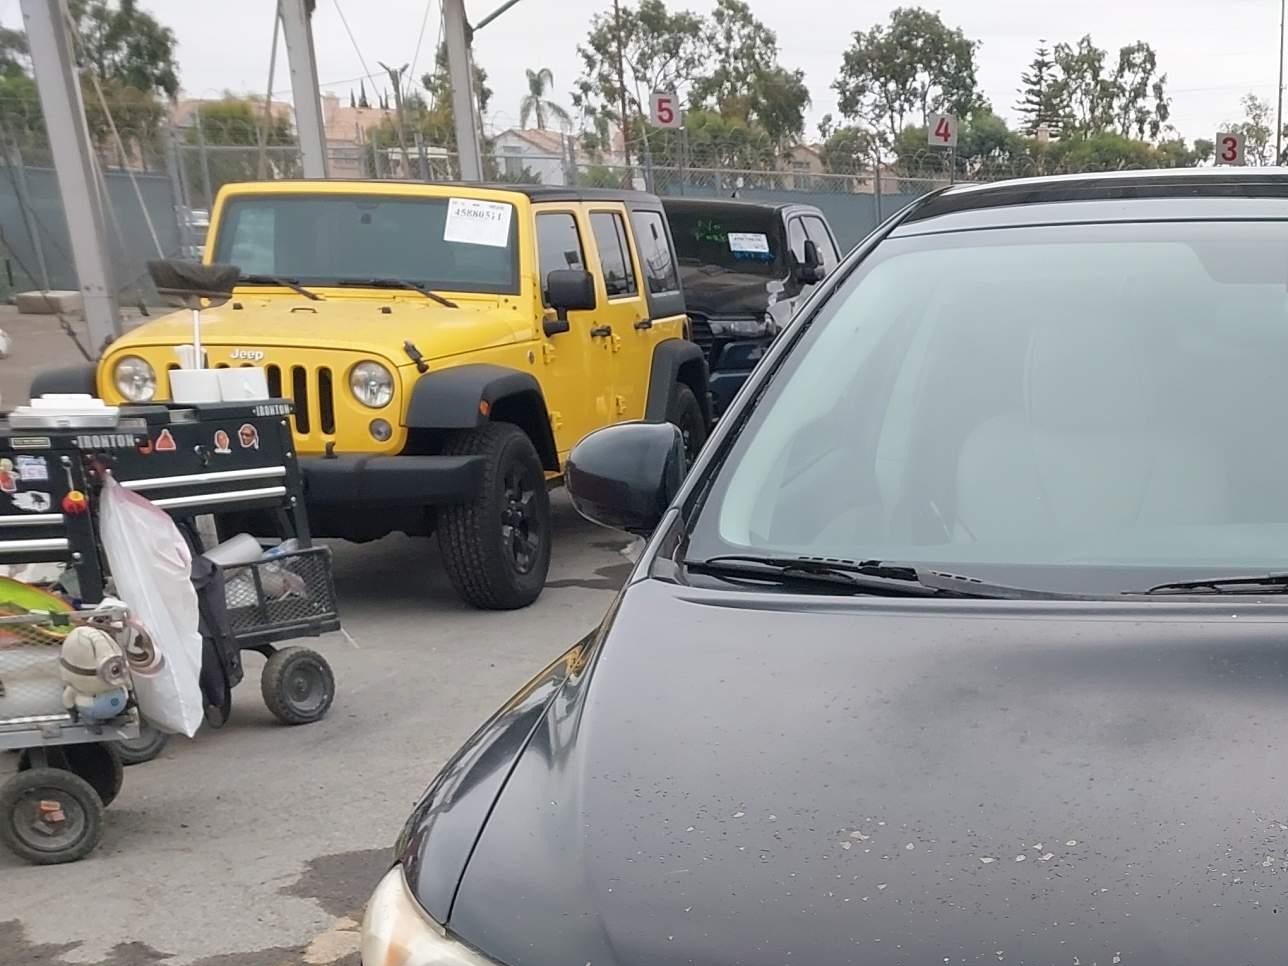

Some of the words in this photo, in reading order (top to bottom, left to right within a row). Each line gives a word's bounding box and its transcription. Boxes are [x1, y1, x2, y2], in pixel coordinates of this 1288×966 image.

[657, 98, 674, 124] 5
[934, 117, 951, 142] 4
[1221, 136, 1238, 162] 3
[230, 348, 264, 361] Jeep
[77, 434, 136, 449] IRONTON
